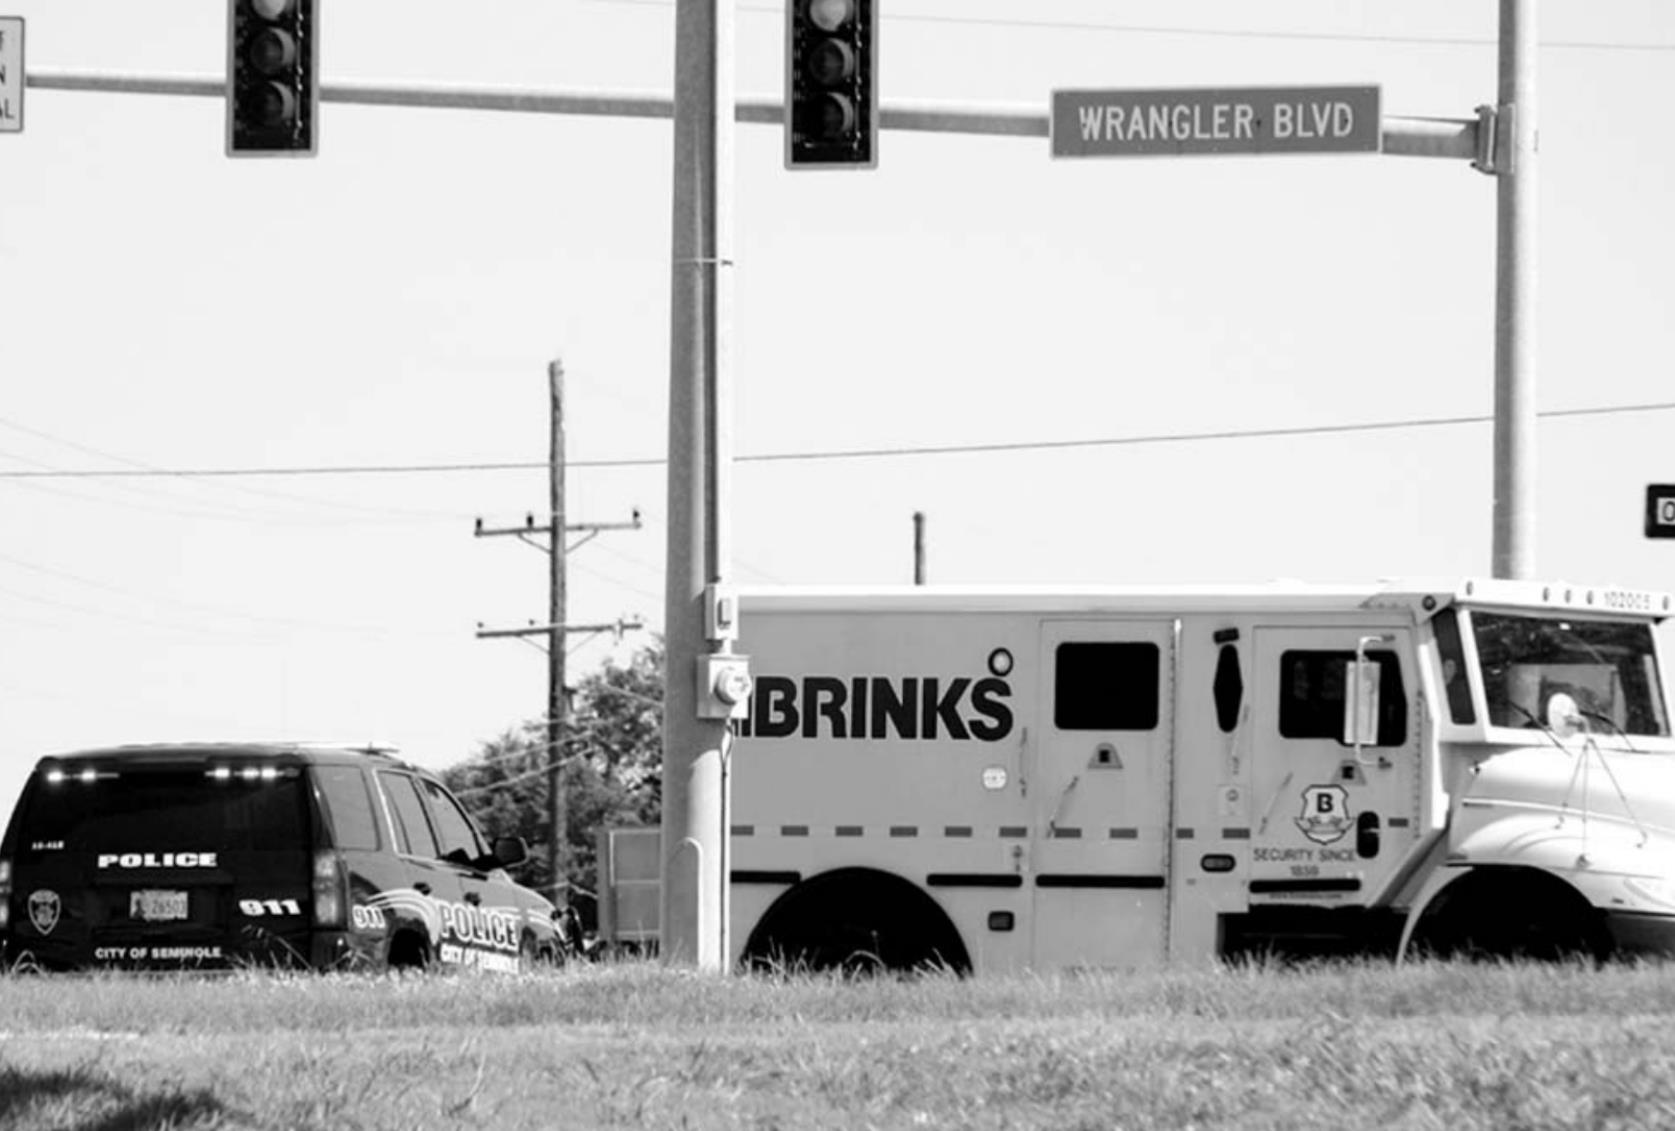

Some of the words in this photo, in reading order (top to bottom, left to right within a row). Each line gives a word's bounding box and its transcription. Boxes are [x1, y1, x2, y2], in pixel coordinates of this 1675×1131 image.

[1079, 104, 1254, 141] WRANGLER
[1273, 102, 1354, 138] BLVD
[1316, 793, 1334, 813] B
[98, 853, 218, 868] POLICE
[1253, 848, 1313, 862] SECURITY
[239, 899, 301, 916] 911
[353, 905, 386, 929] 911
[440, 902, 520, 951] POLICE
[95, 947, 126, 959] CITY
[130, 947, 147, 959] OF
